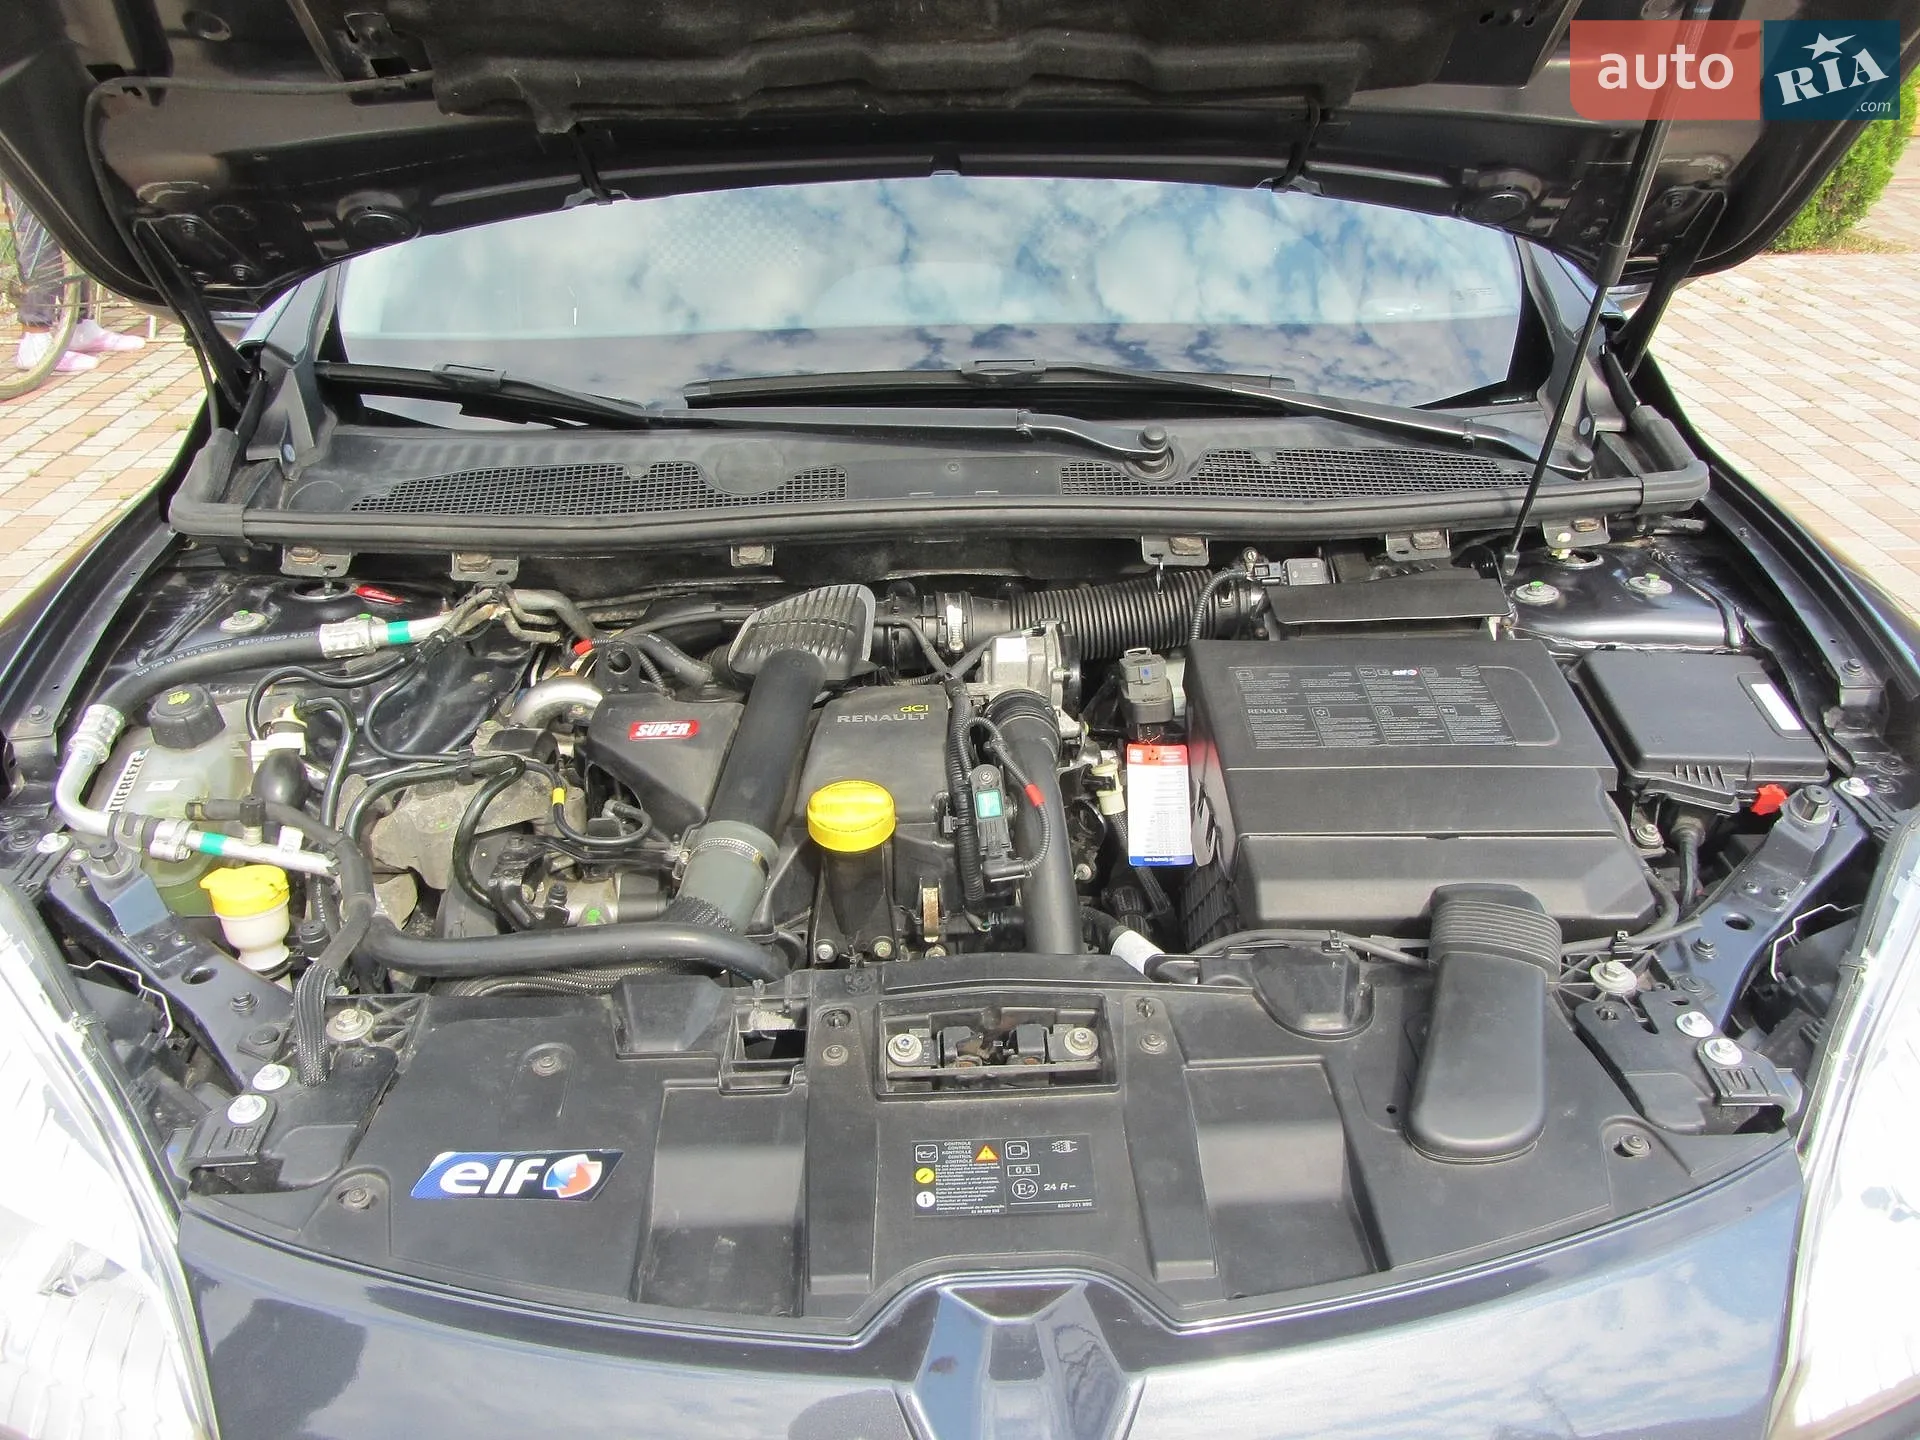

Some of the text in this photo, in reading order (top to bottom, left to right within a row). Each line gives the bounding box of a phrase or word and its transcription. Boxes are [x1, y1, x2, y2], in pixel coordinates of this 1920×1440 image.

[837, 712, 929, 723] RENAULT
[635, 723, 691, 737] SUPER
[439, 1158, 547, 1194] elf
[1015, 1166, 1032, 1175] 0,5
[1016, 1183, 1036, 1195] E2
[1043, 1183, 1057, 1191] 24
